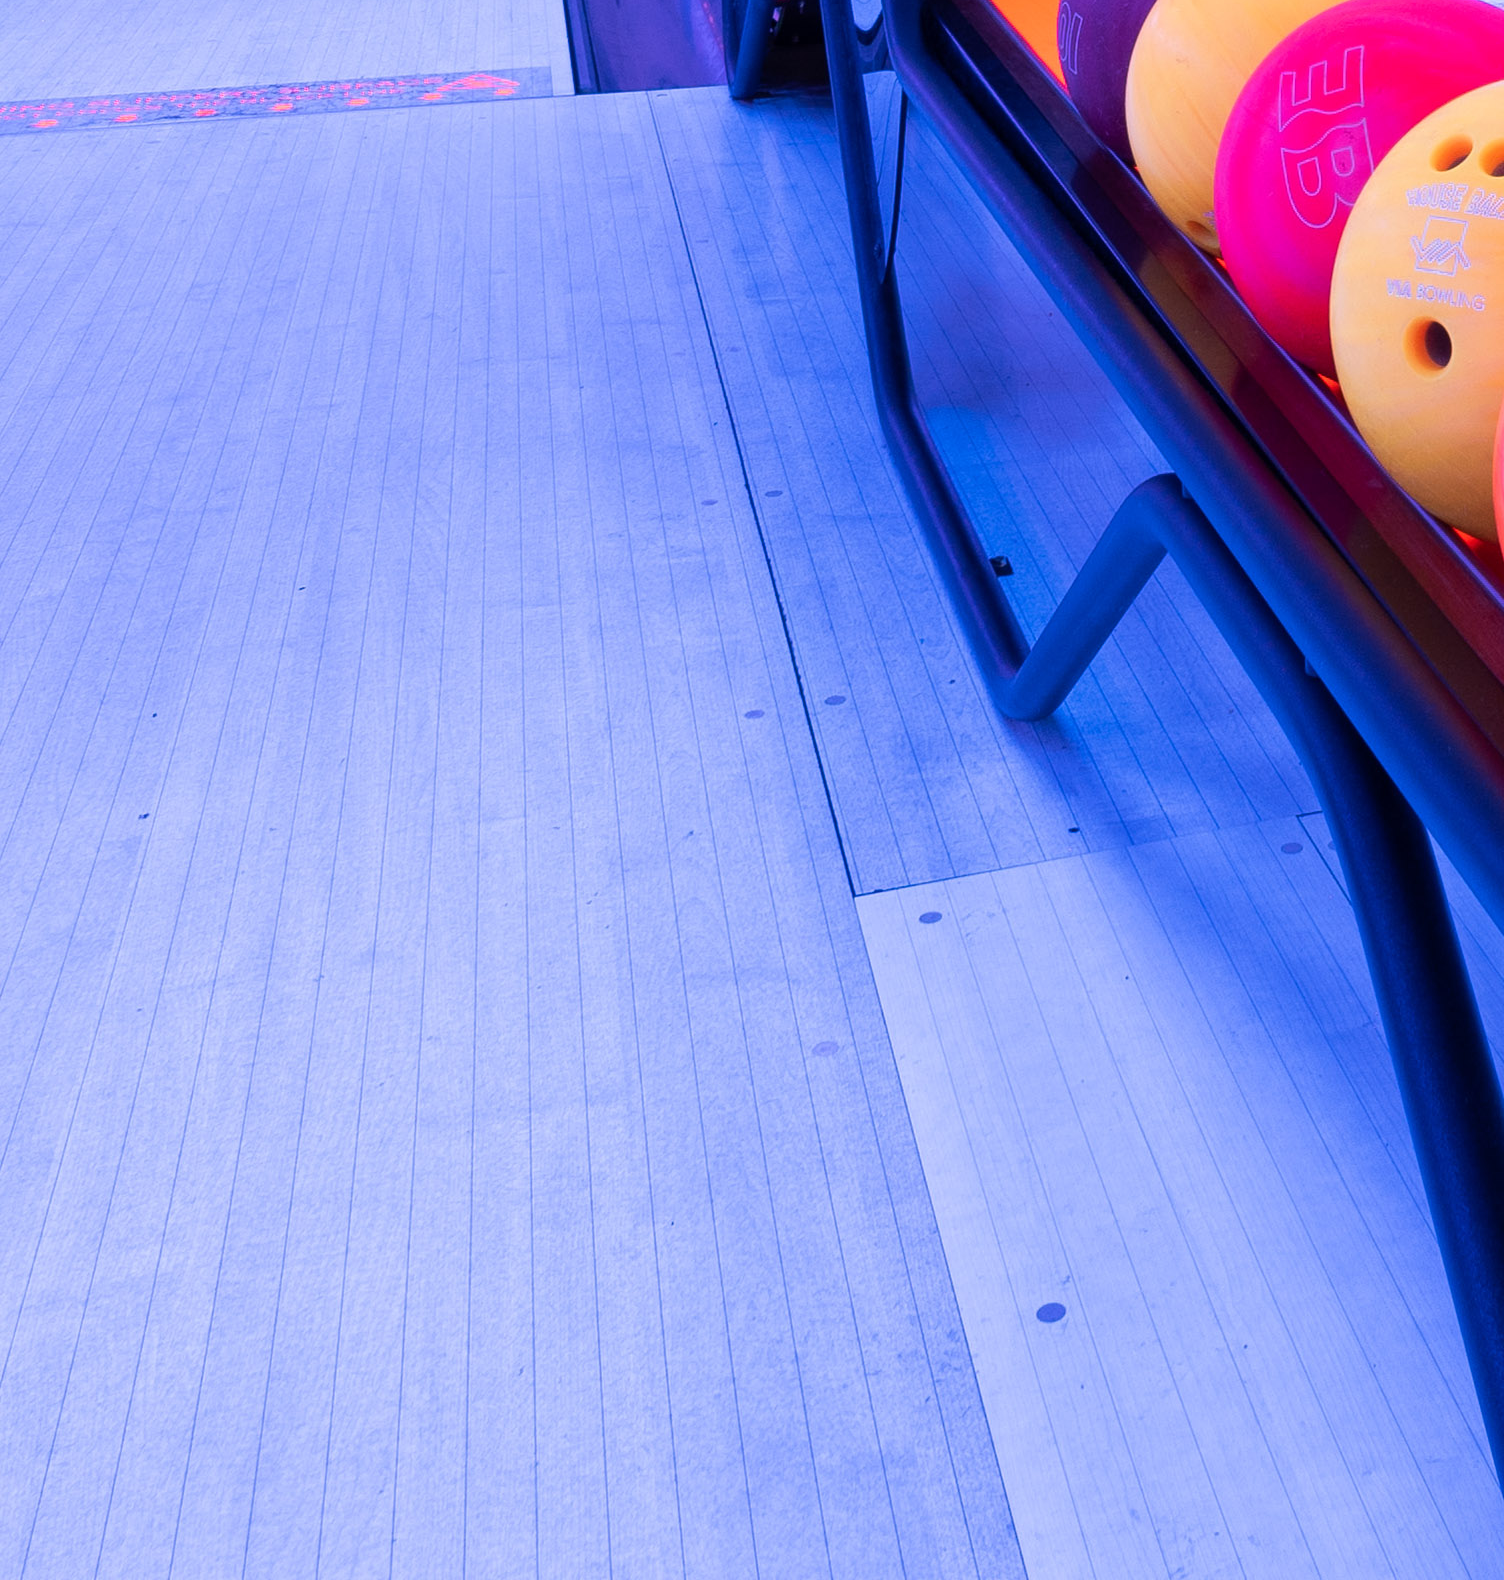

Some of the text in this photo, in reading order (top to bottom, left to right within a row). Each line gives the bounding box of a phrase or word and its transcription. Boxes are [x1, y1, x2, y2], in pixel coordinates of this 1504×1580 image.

[1406, 183, 1468, 212] HOUSE
[1386, 278, 1486, 311] VIA BOWLING
